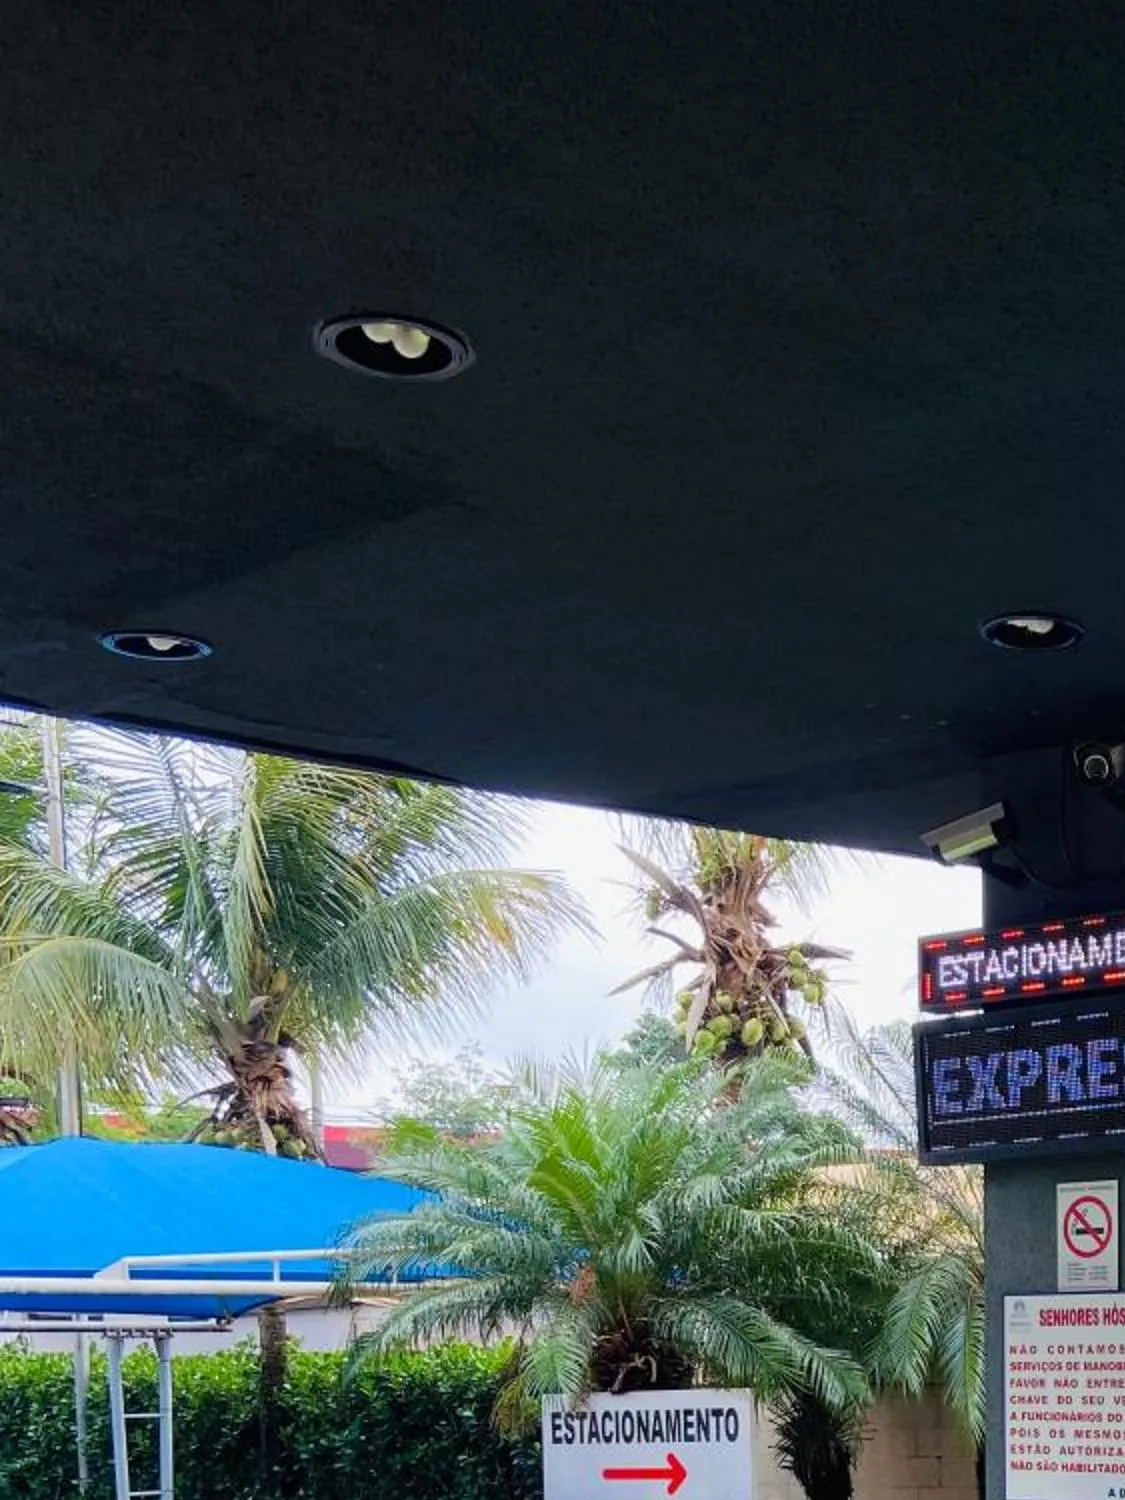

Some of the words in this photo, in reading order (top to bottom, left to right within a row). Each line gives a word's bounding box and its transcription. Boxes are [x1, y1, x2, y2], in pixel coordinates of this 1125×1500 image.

[1039, 1307, 1099, 1327] SENHORES
[1009, 1343, 1037, 1355] NÃO
[1047, 1343, 1125, 1355] CONTAMOS
[1009, 1362, 1063, 1374] SERVIÇOS
[1065, 1361, 1081, 1372] DE
[1009, 1379, 1046, 1389] FAVOR
[1053, 1377, 1079, 1389] NÃO
[1009, 1396, 1048, 1405] CHAVE
[1057, 1396, 1073, 1405] DO
[1081, 1396, 1104, 1405] SEU
[1009, 1412, 1018, 1421] A
[1021, 1411, 1103, 1422] FUNCIONÁRIOS
[1107, 1414, 1123, 1422] DO
[551, 1408, 739, 1444] ESTACIONAMENTO
[1009, 1428, 1041, 1438] POIS
[1050, 1429, 1065, 1439] OS
[1010, 1443, 1050, 1455] ESTÃO
[1010, 1461, 1033, 1471] NÃO
[1036, 1461, 1058, 1472] SÃO
[1108, 1489, 1116, 1499] A
